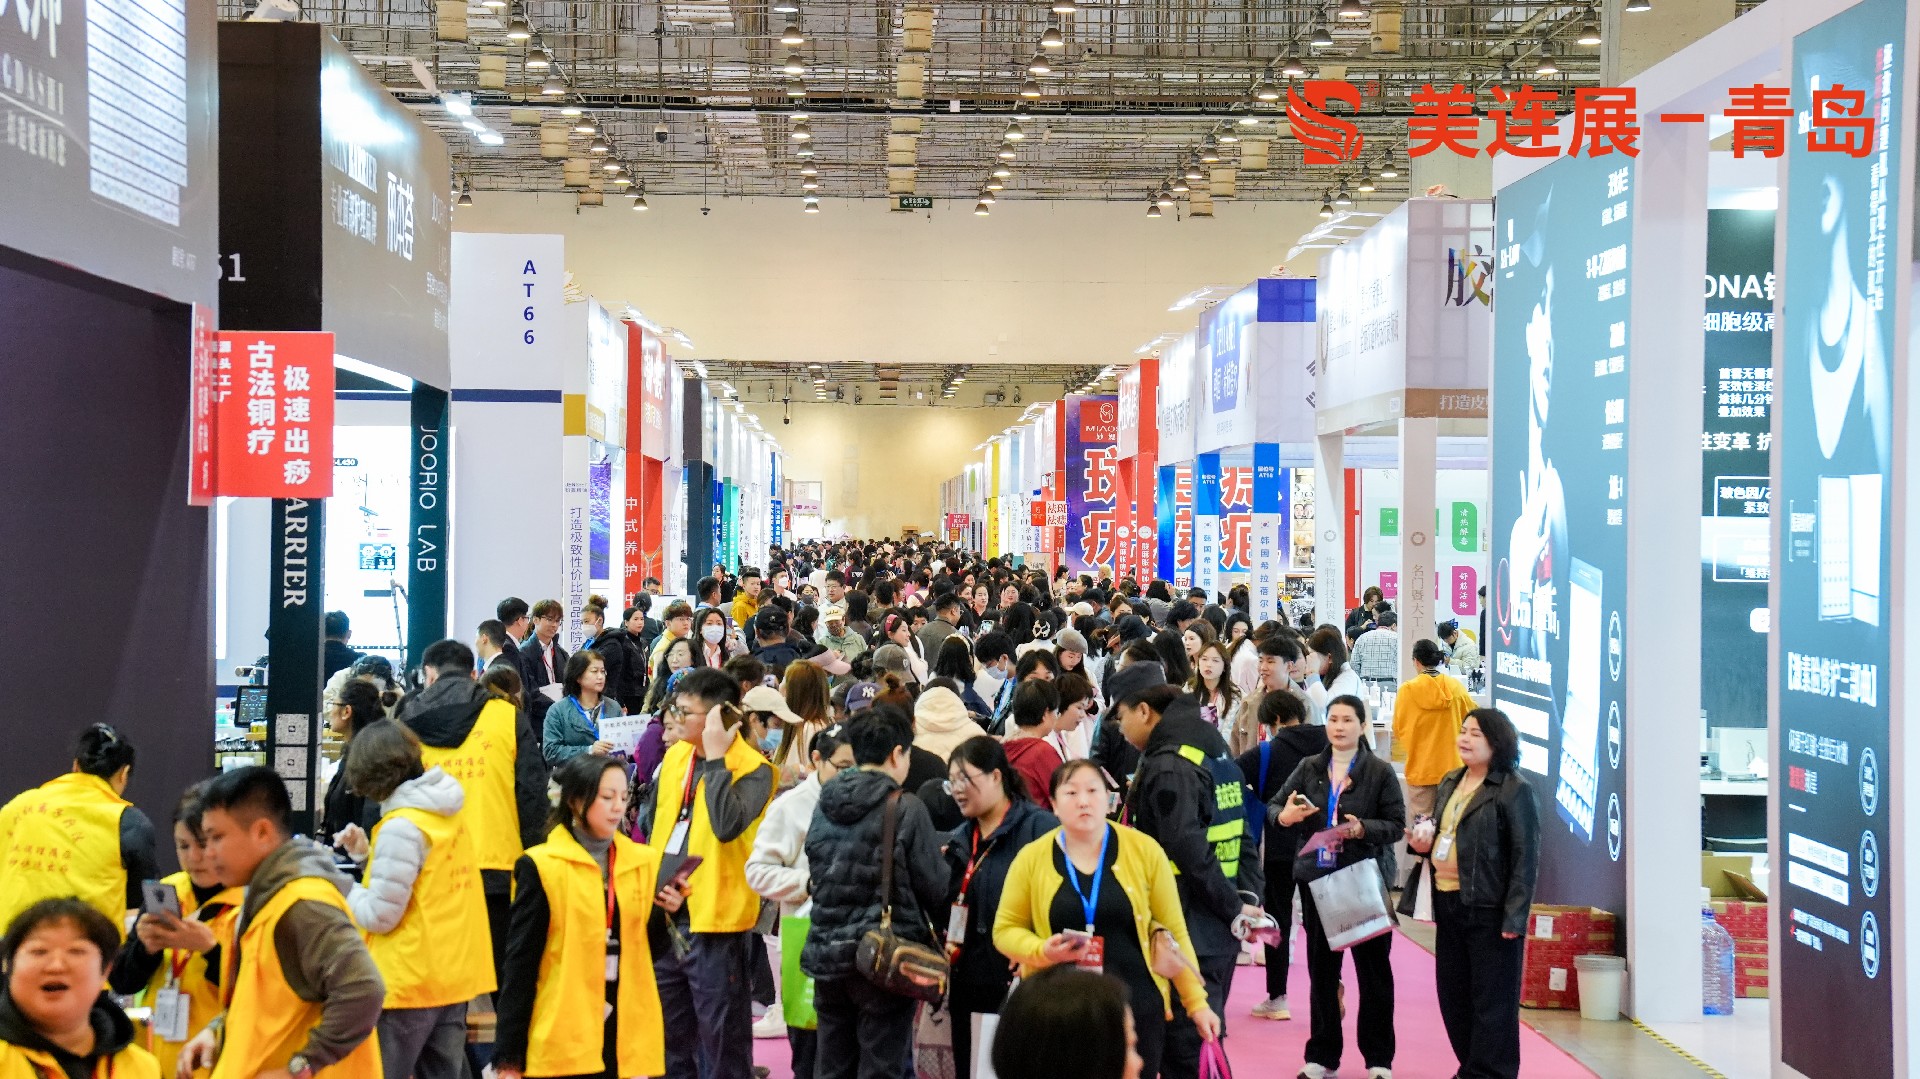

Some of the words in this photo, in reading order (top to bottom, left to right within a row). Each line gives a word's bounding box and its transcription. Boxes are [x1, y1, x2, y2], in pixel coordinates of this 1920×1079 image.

[523, 259, 537, 345] AT66
[247, 340, 276, 455] 古法铜疗
[283, 365, 311, 485] 极速出痧
[419, 425, 438, 510] JOORIO
[417, 524, 438, 572] LAB
[624, 496, 638, 578] 中式养护
